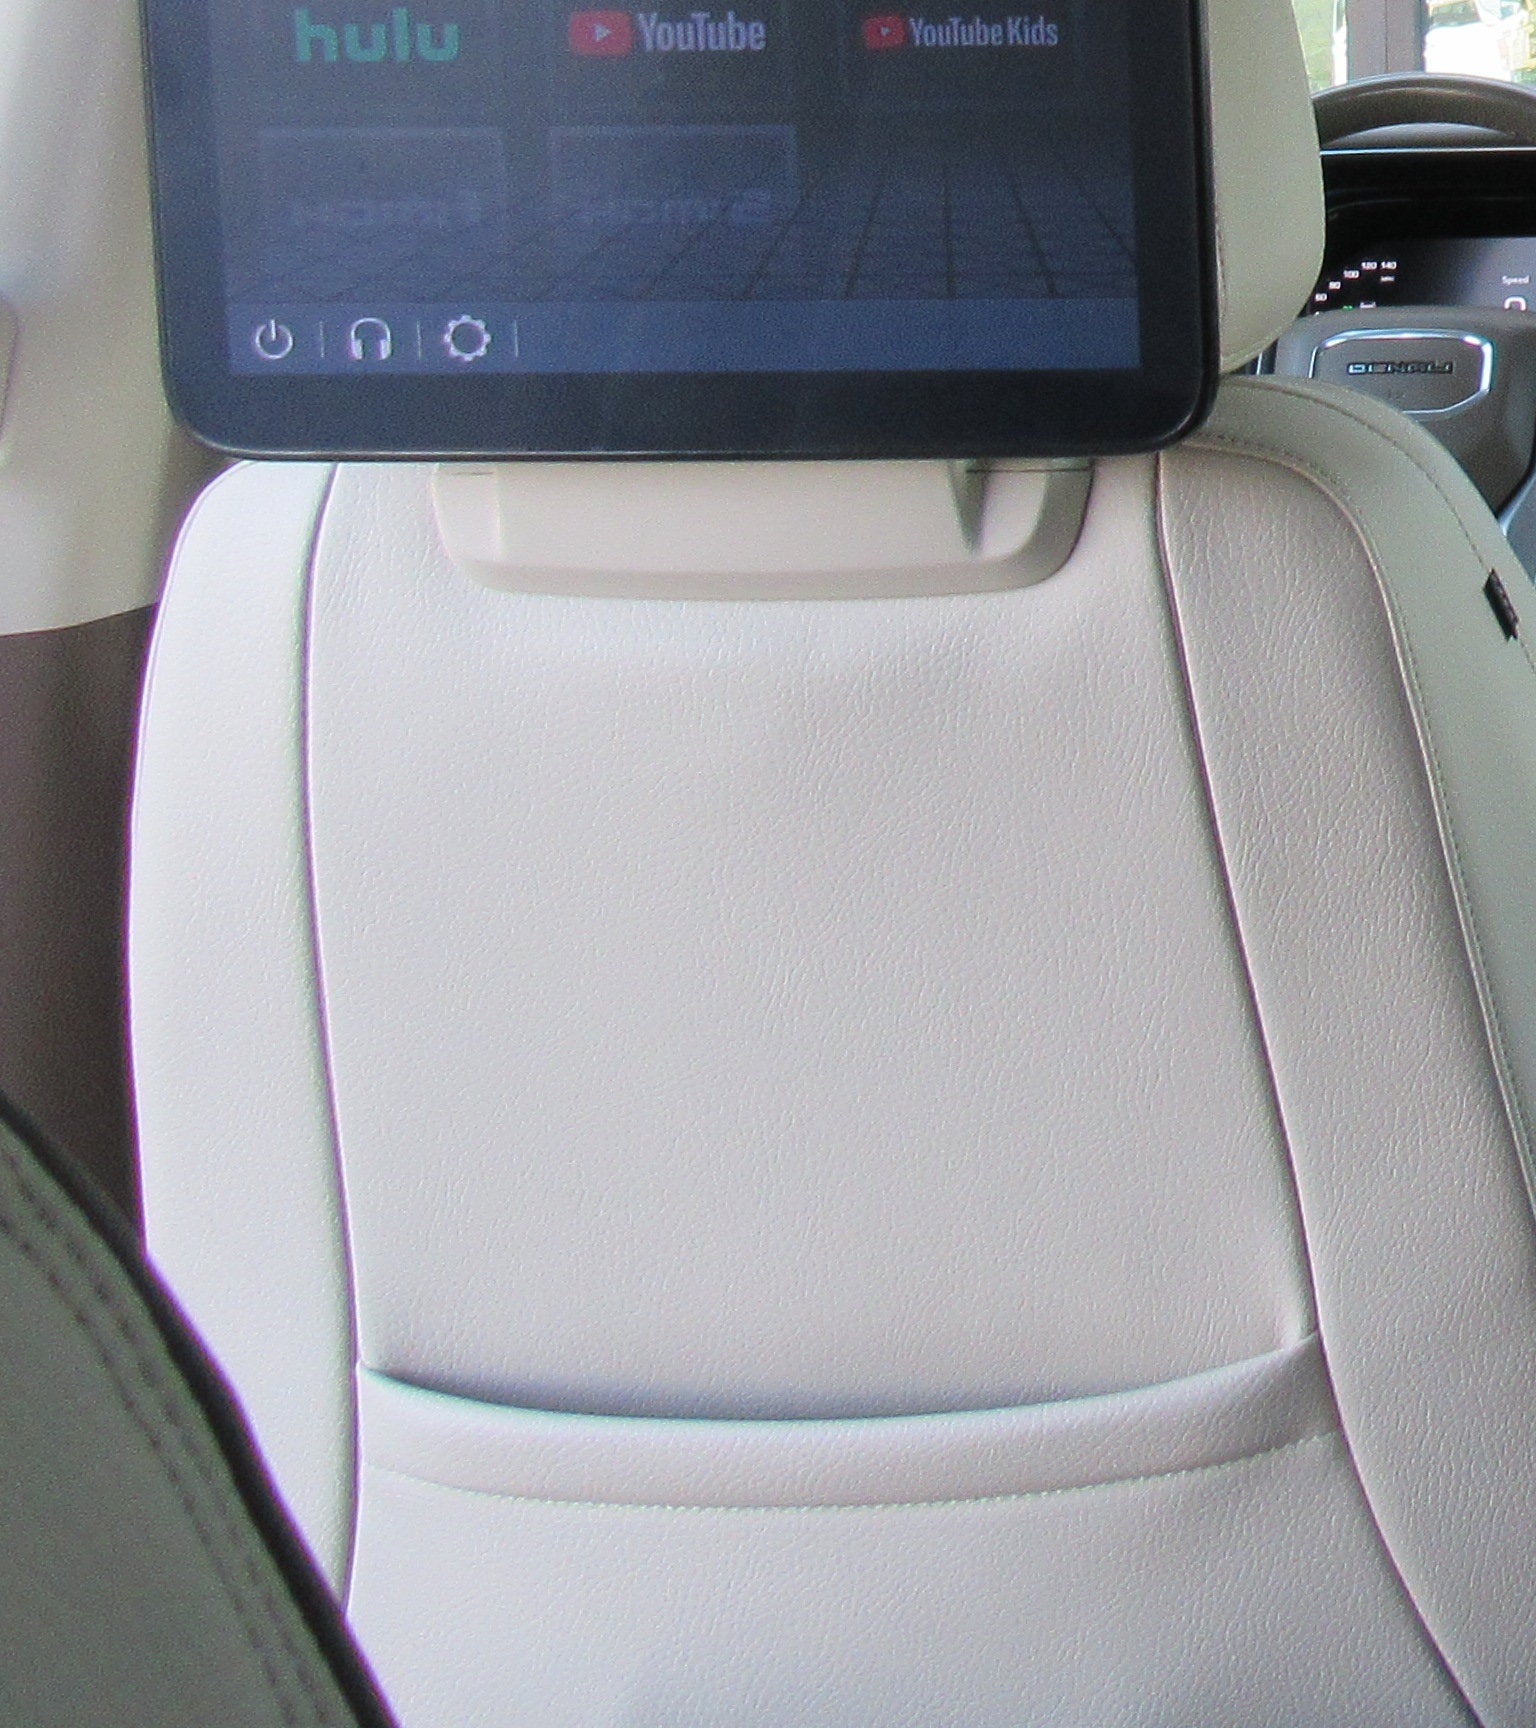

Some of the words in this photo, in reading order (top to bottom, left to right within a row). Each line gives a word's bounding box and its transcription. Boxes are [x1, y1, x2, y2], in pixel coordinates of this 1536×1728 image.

[294, 6, 460, 64] hulu
[638, 12, 766, 53] YouTube
[909, 16, 1003, 48] YouTube
[1005, 15, 1059, 48] Kids
[1502, 275, 1530, 285] Speed
